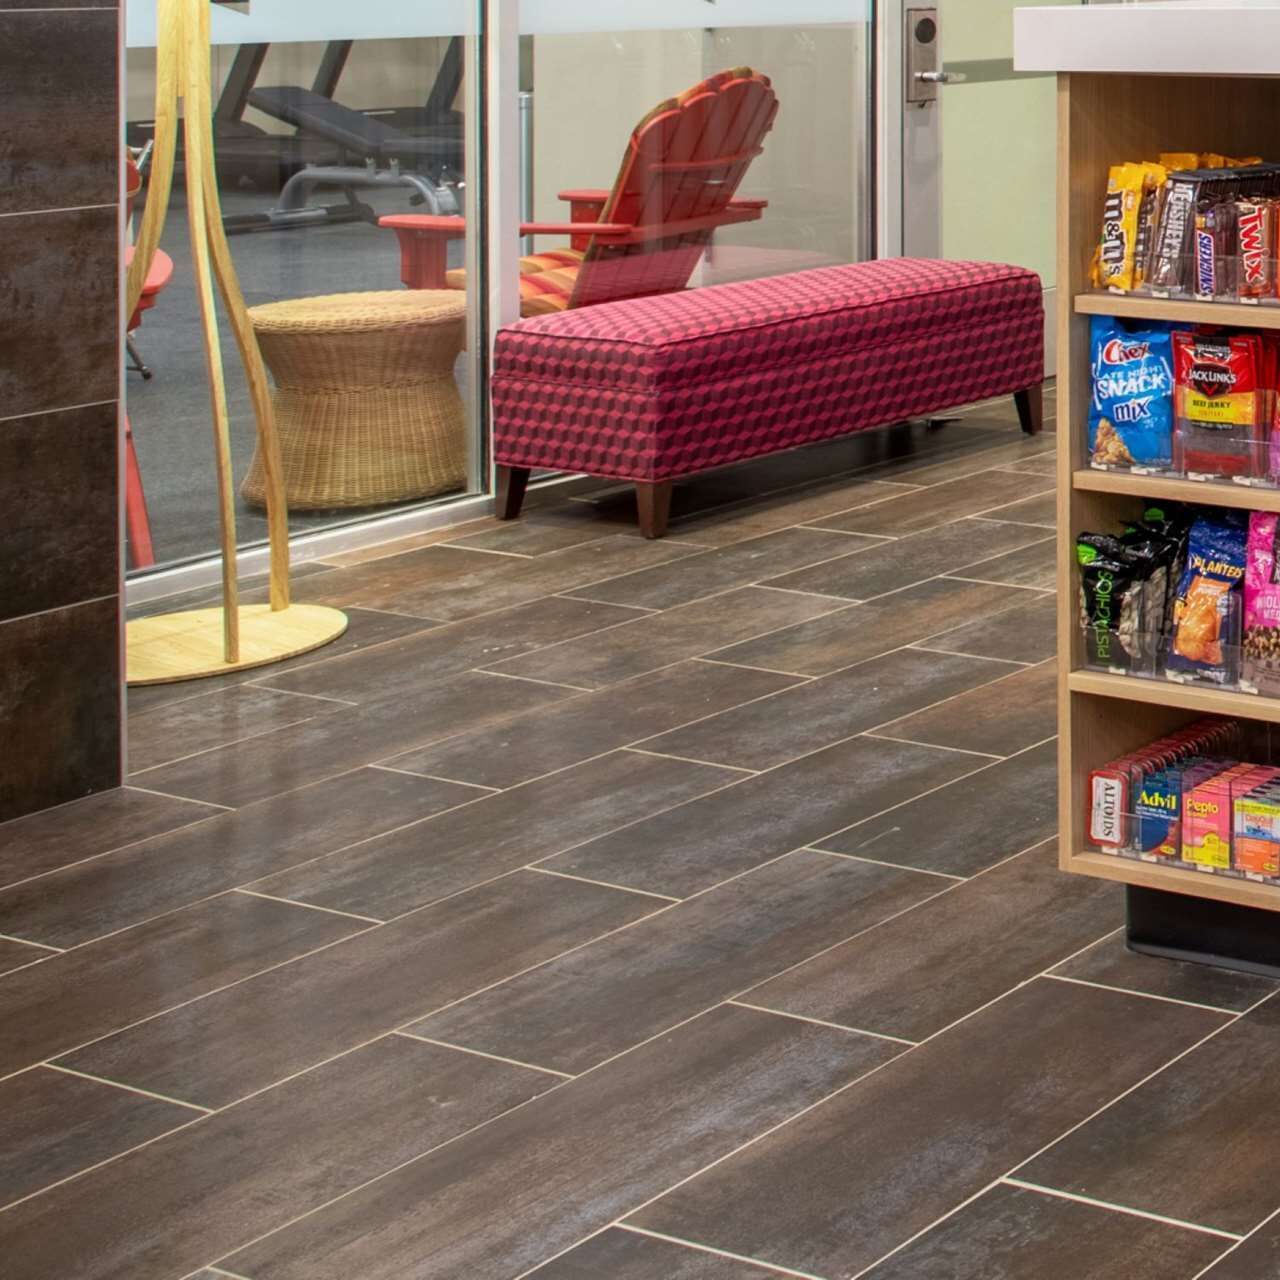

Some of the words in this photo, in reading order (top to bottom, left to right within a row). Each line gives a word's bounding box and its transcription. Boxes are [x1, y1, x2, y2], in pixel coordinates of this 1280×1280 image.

[1199, 233, 1214, 294] SNICKERS
[1103, 338, 1152, 365] Chex
[1097, 373, 1167, 399] SNACK
[1113, 396, 1153, 422] mix
[1103, 782, 1116, 838] ALTOIDS
[1140, 790, 1177, 810] Advil
[1186, 798, 1219, 814] Pepto
